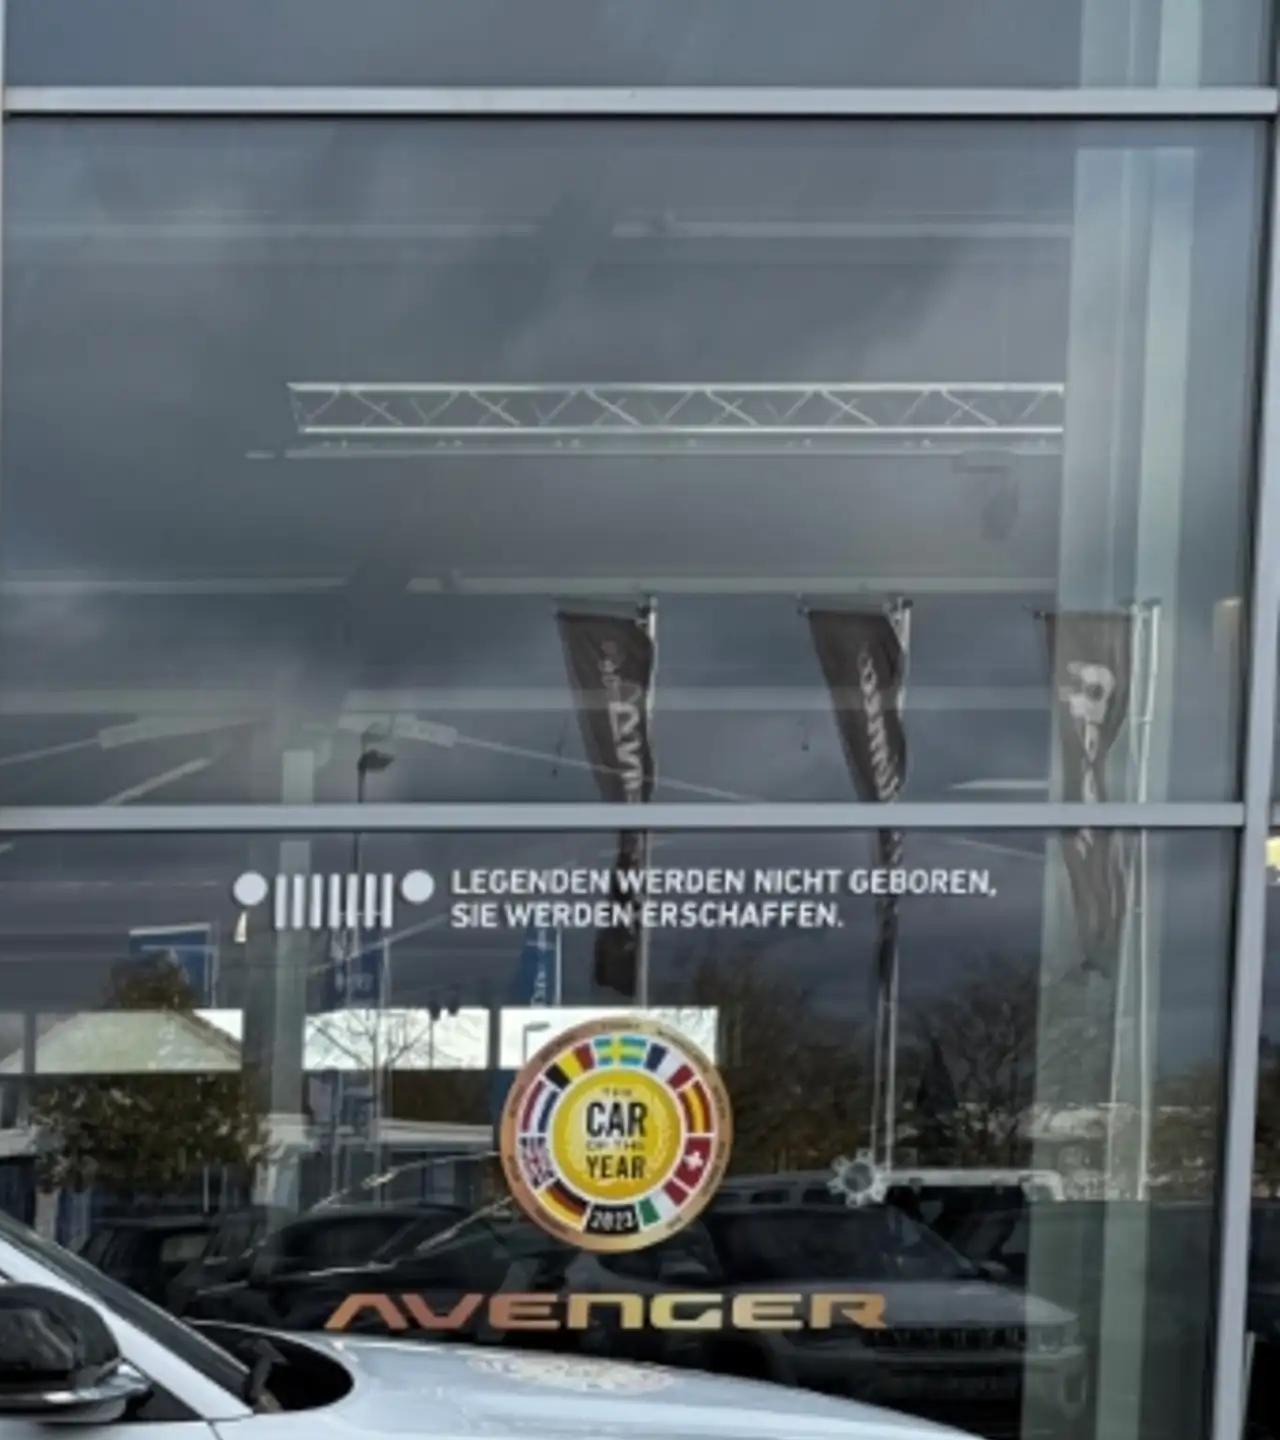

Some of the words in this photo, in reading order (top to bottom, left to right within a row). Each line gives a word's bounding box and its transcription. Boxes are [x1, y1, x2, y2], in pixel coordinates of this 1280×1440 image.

[450, 869, 610, 894] LEGENDEN
[617, 869, 745, 894] WERDEN
[754, 869, 842, 894] NICHT
[848, 869, 997, 897] GEBOREN,
[450, 903, 498, 928] SIE
[505, 903, 633, 928] WERDEN
[642, 902, 844, 928] ERSCHAFFEN.
[586, 1102, 648, 1137] CAR
[586, 1155, 646, 1179] YEAR
[324, 1292, 888, 1330] AVENGER
